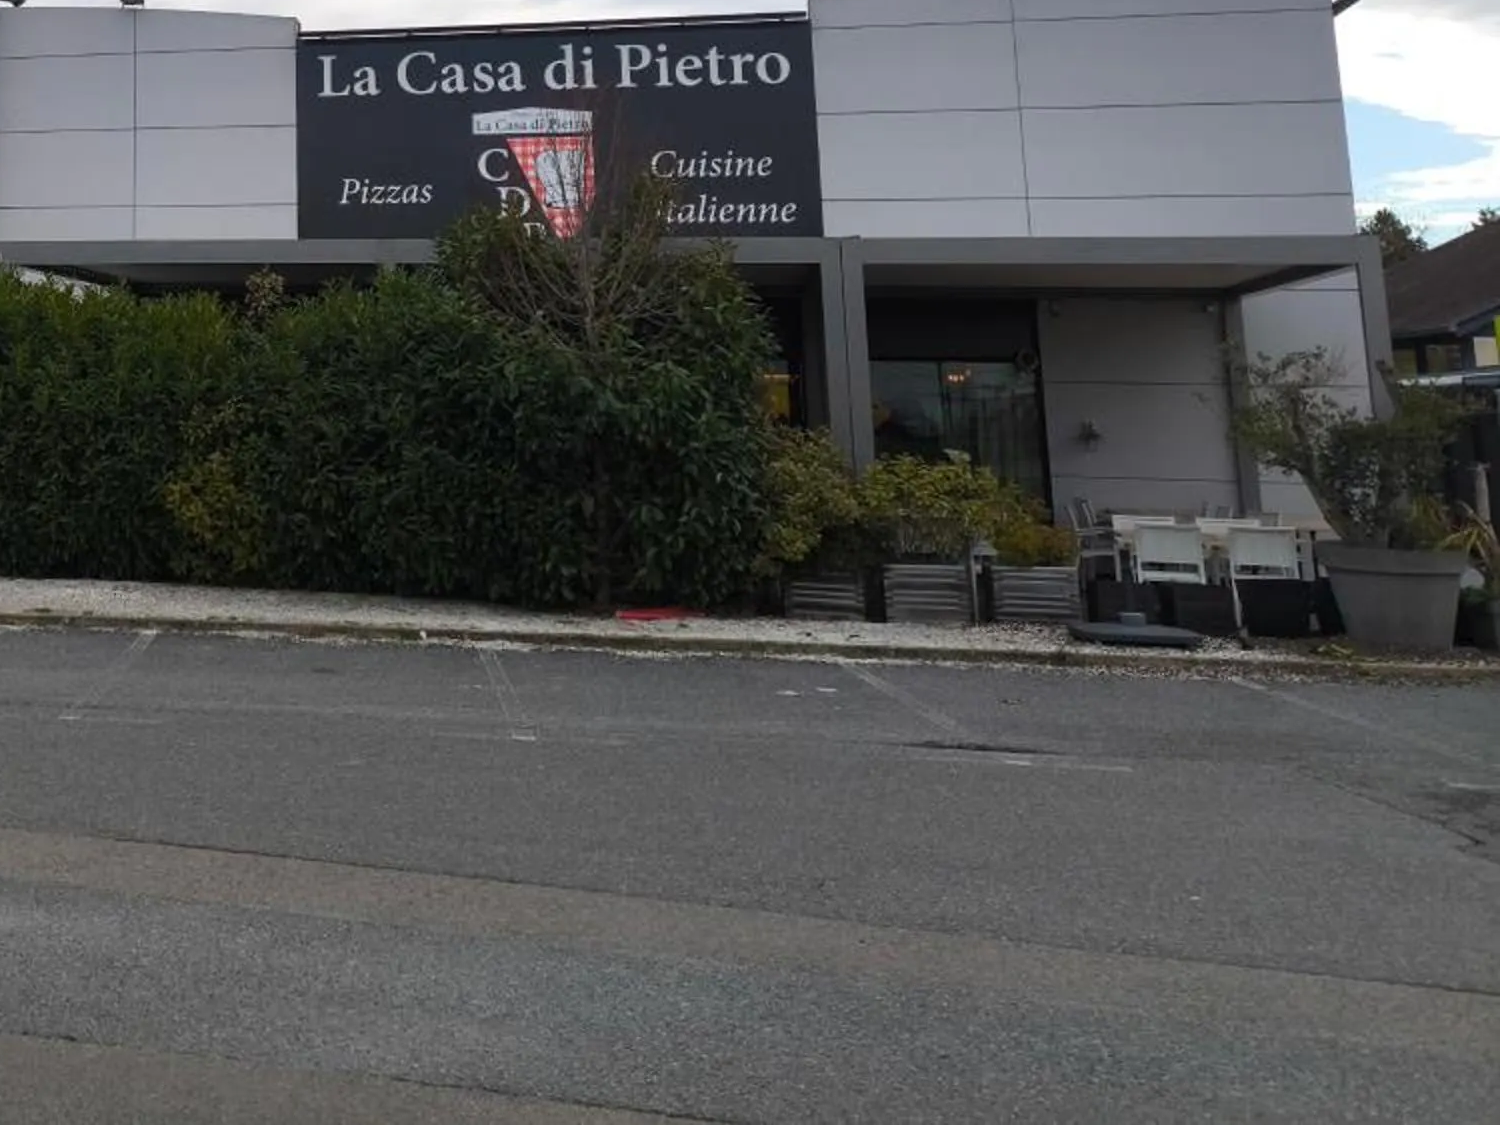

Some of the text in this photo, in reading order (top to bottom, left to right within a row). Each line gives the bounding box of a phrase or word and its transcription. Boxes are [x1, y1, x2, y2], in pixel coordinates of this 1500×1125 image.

[318, 42, 791, 98] La Casa di Pietro
[477, 148, 509, 182] C
[651, 150, 773, 178] Cuisine
[339, 178, 433, 204] Pizzas
